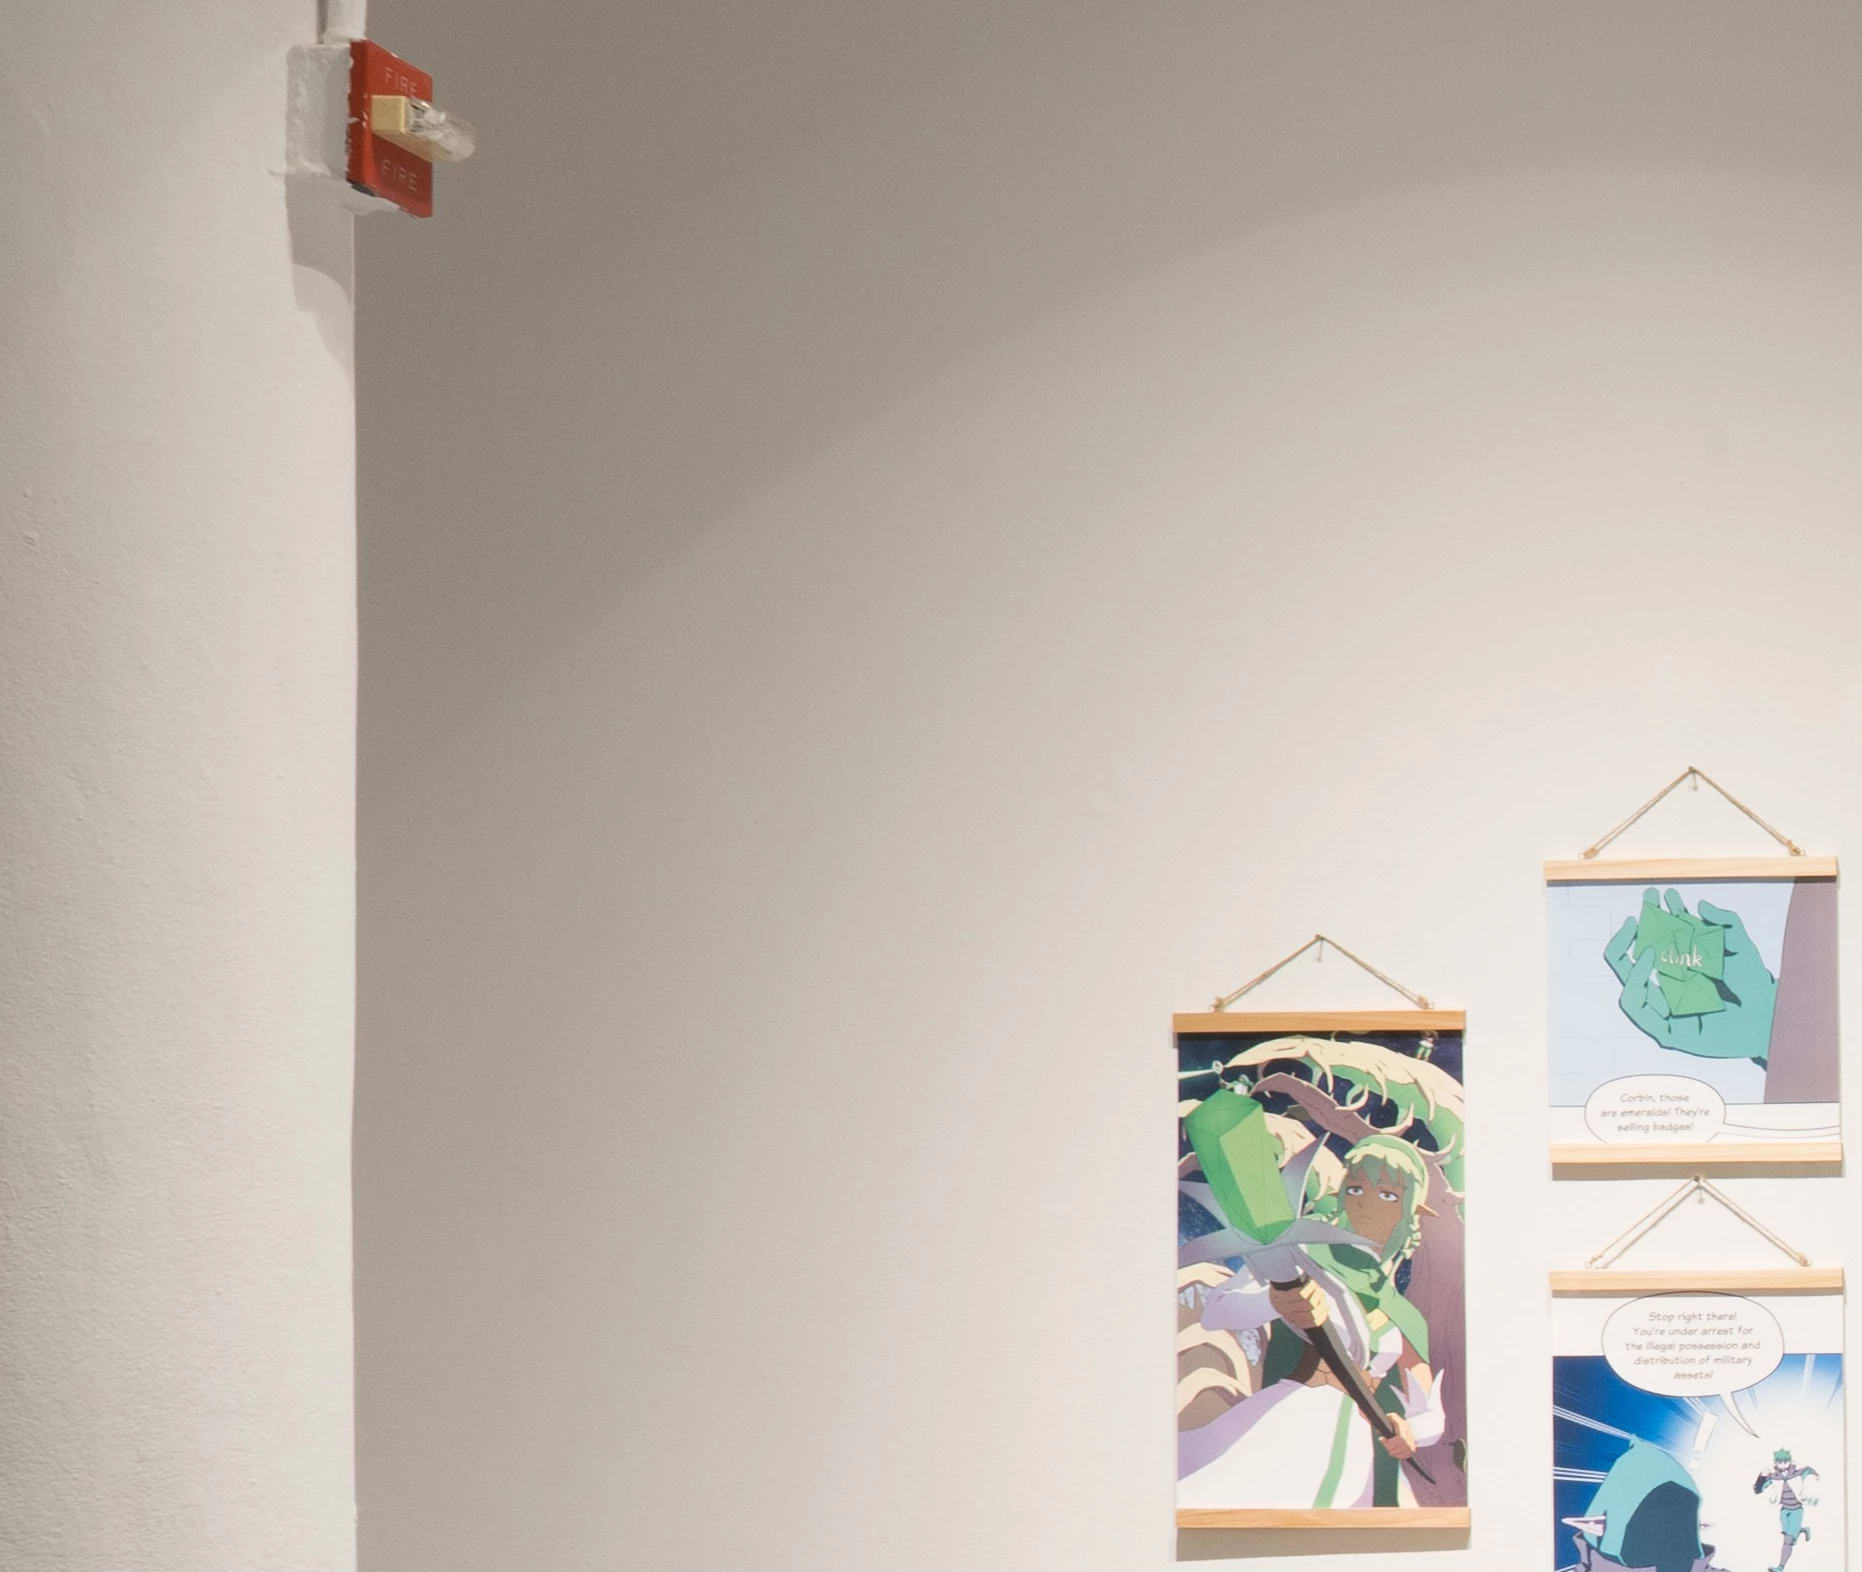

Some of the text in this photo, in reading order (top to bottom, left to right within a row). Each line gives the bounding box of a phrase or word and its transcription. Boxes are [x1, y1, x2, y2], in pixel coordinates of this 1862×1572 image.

[385, 66, 417, 98] FIRE
[382, 159, 417, 192] FIRE
[1660, 1093, 1690, 1102] those
[1600, 1110, 1617, 1118] are
[1649, 1311, 1675, 1323] Stop
[1678, 1312, 1702, 1323] right
[1668, 1327, 1697, 1336] under
[1737, 1326, 1753, 1335] for
[1625, 1342, 1644, 1351] the
[1678, 1342, 1740, 1352] possession
[1741, 1341, 1761, 1350] and
[1633, 1355, 1753, 1366] distribution of military
